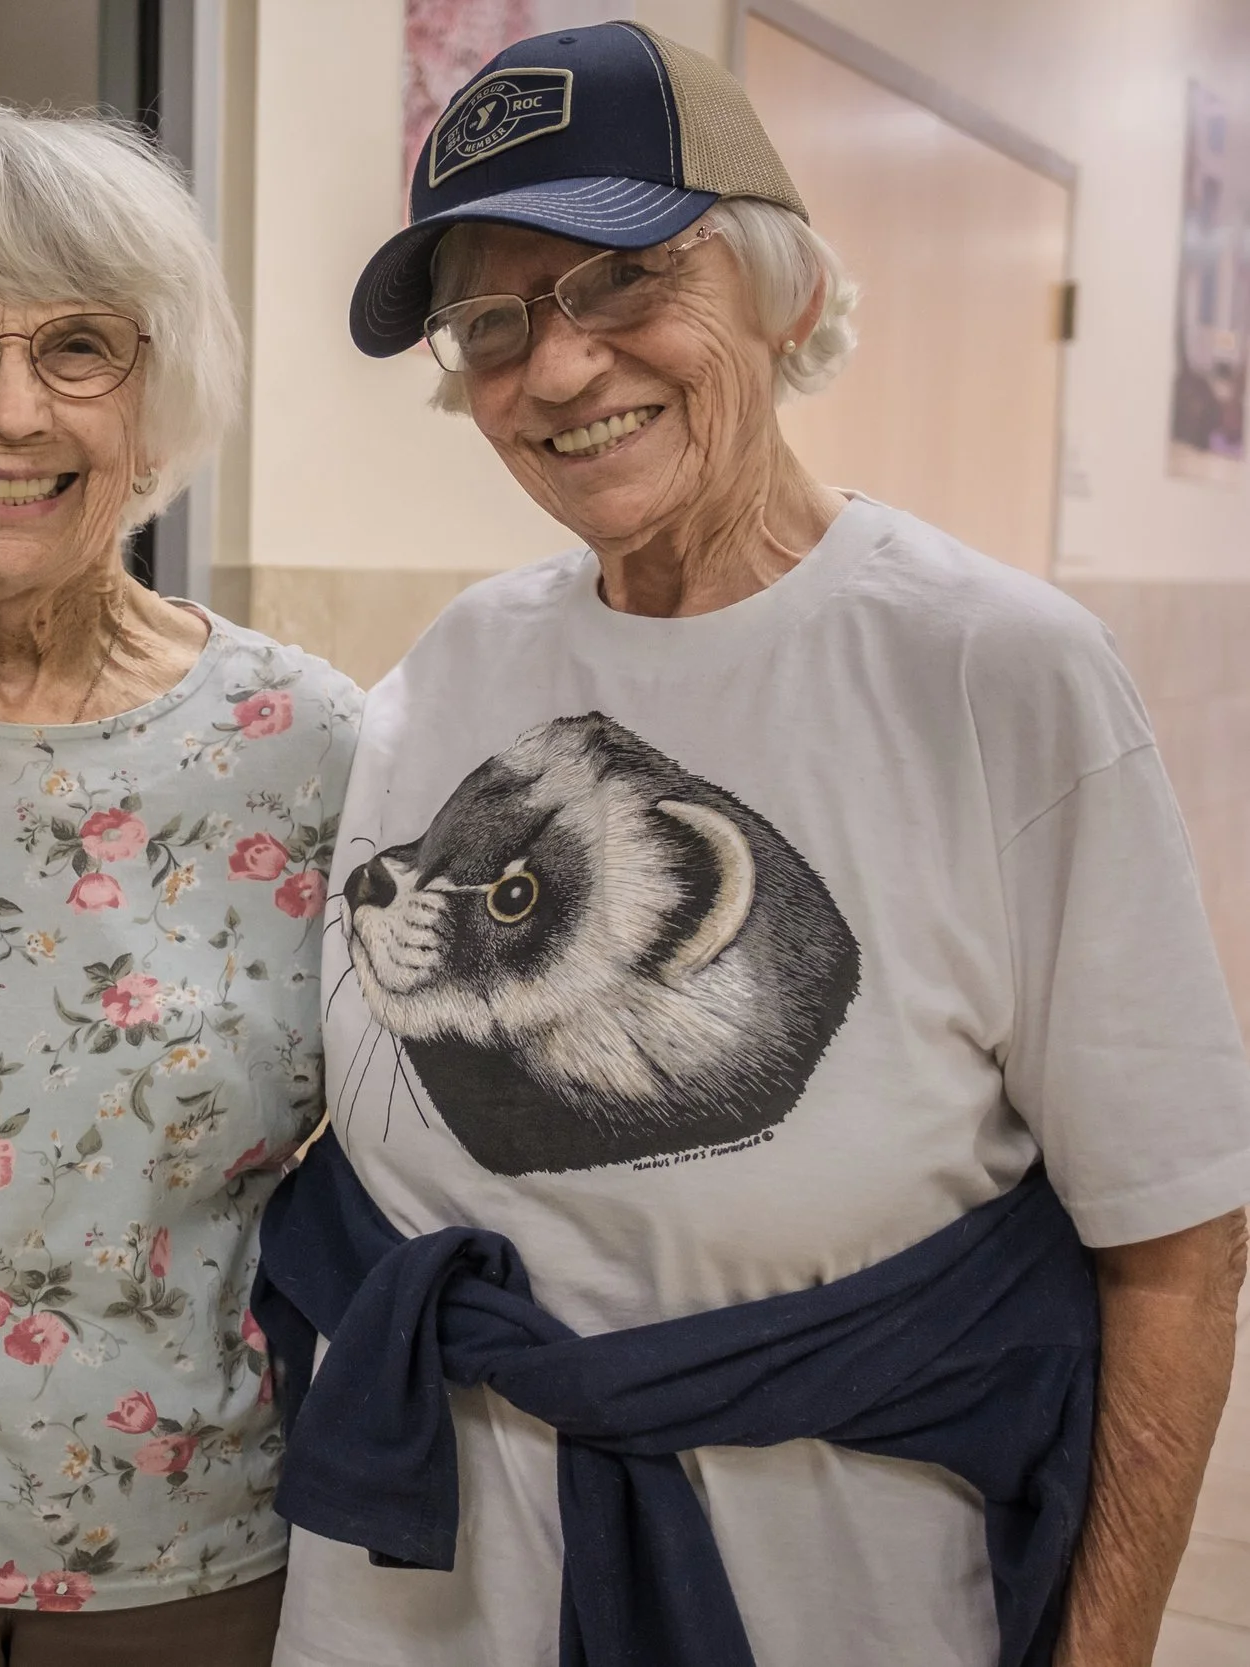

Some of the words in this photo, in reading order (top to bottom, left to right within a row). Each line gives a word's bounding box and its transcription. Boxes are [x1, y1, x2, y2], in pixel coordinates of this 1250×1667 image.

[471, 84, 505, 105] PROUD
[512, 96, 543, 111] ROC
[464, 127, 507, 152] MEMBER
[633, 1158, 670, 1171] FAMOUS
